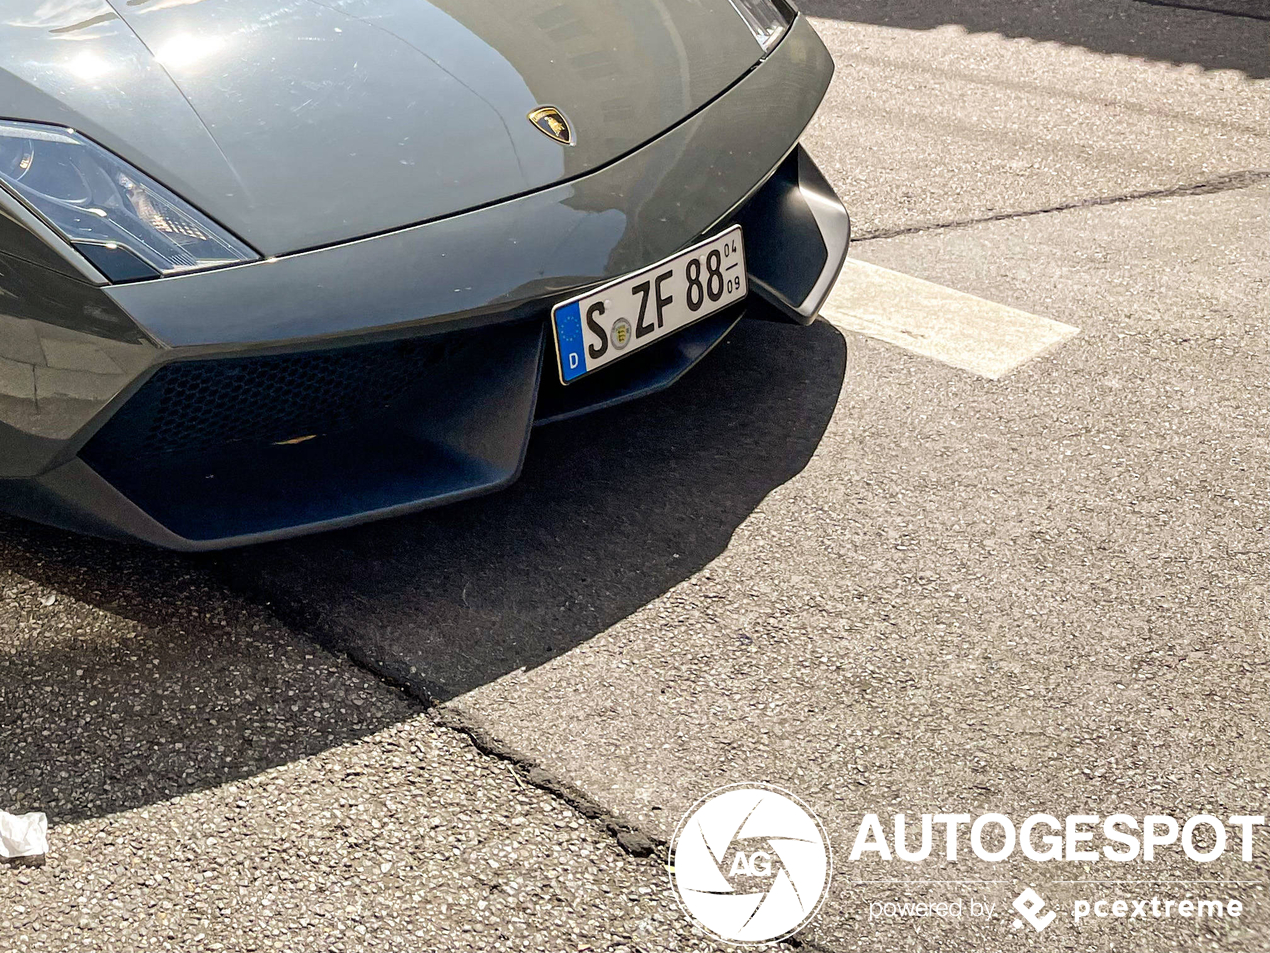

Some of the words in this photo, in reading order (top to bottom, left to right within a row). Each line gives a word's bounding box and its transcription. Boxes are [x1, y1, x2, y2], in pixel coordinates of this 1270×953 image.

[723, 239, 738, 258] 04
[726, 274, 741, 294] 09
[586, 301, 609, 360] S
[632, 270, 673, 338] ZF
[685, 249, 724, 312] 88
[569, 352, 579, 370] D
